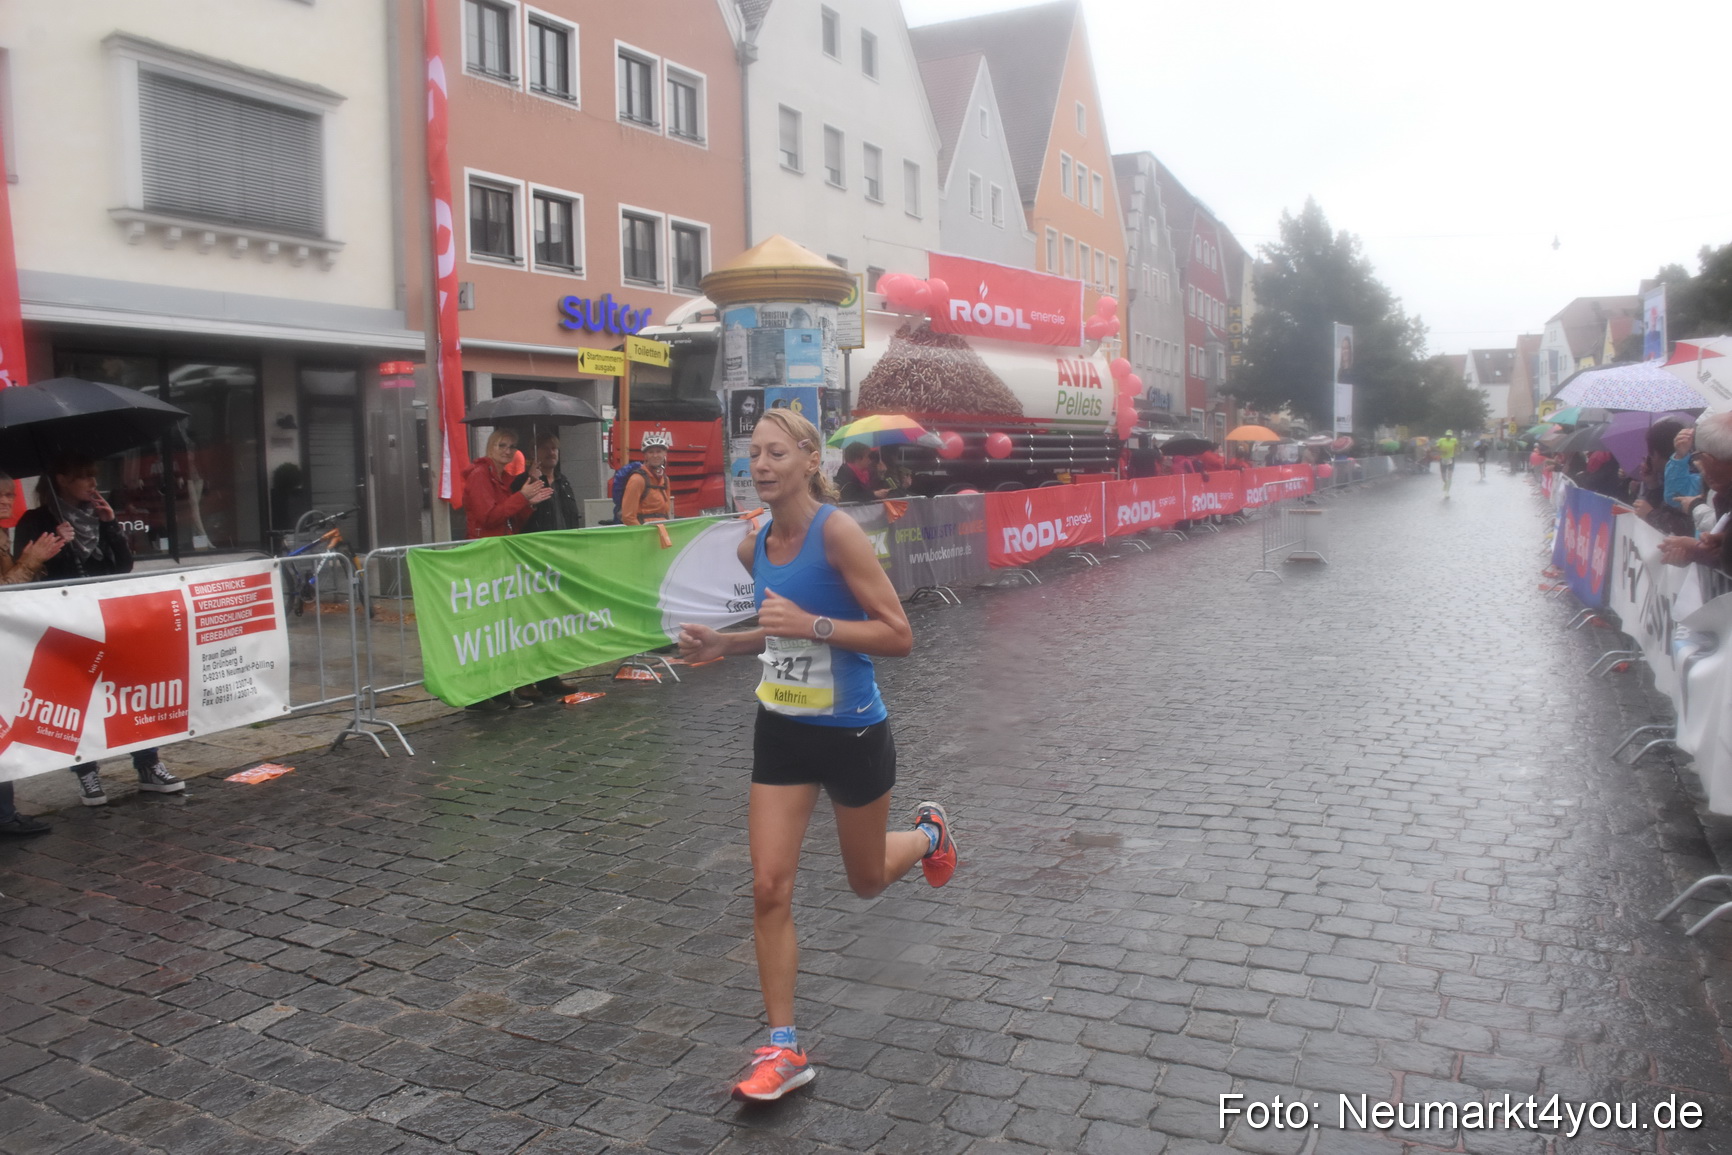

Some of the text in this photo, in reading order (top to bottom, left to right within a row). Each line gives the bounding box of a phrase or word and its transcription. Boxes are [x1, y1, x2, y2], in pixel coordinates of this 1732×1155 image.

[561, 293, 652, 335] sutor
[761, 311, 789, 320] CHRISTIAN
[1031, 309, 1065, 325] energie
[586, 351, 624, 363] Startnummern-
[634, 344, 661, 359] Toiletten
[594, 363, 616, 374] ausgabe
[1056, 355, 1102, 389] AVIA
[1055, 390, 1102, 417] Pellets
[194, 579, 246, 595] BINDESTRICKE
[451, 563, 561, 614] Herzlich
[198, 591, 258, 611] VERZURRSYSTEME
[171, 600, 182, 632] Seit 1929
[200, 608, 253, 627] RUNDSCHLINGEN
[200, 626, 243, 643] HEBEBÄNDER
[453, 607, 615, 667] Willkommen
[202, 646, 237, 662] Braun GmbH
[202, 663, 211, 673] Am
[212, 656, 238, 670] Grünberg
[104, 678, 182, 718] Braun
[203, 687, 214, 697] Tel.
[774, 688, 807, 704] Kathrin
[16, 687, 80, 731] Braun
[202, 697, 214, 707] Fax
[134, 709, 189, 727] Sicher ist sicher
[36, 726, 55, 737] Sicher
[63, 732, 81, 743] sicher
